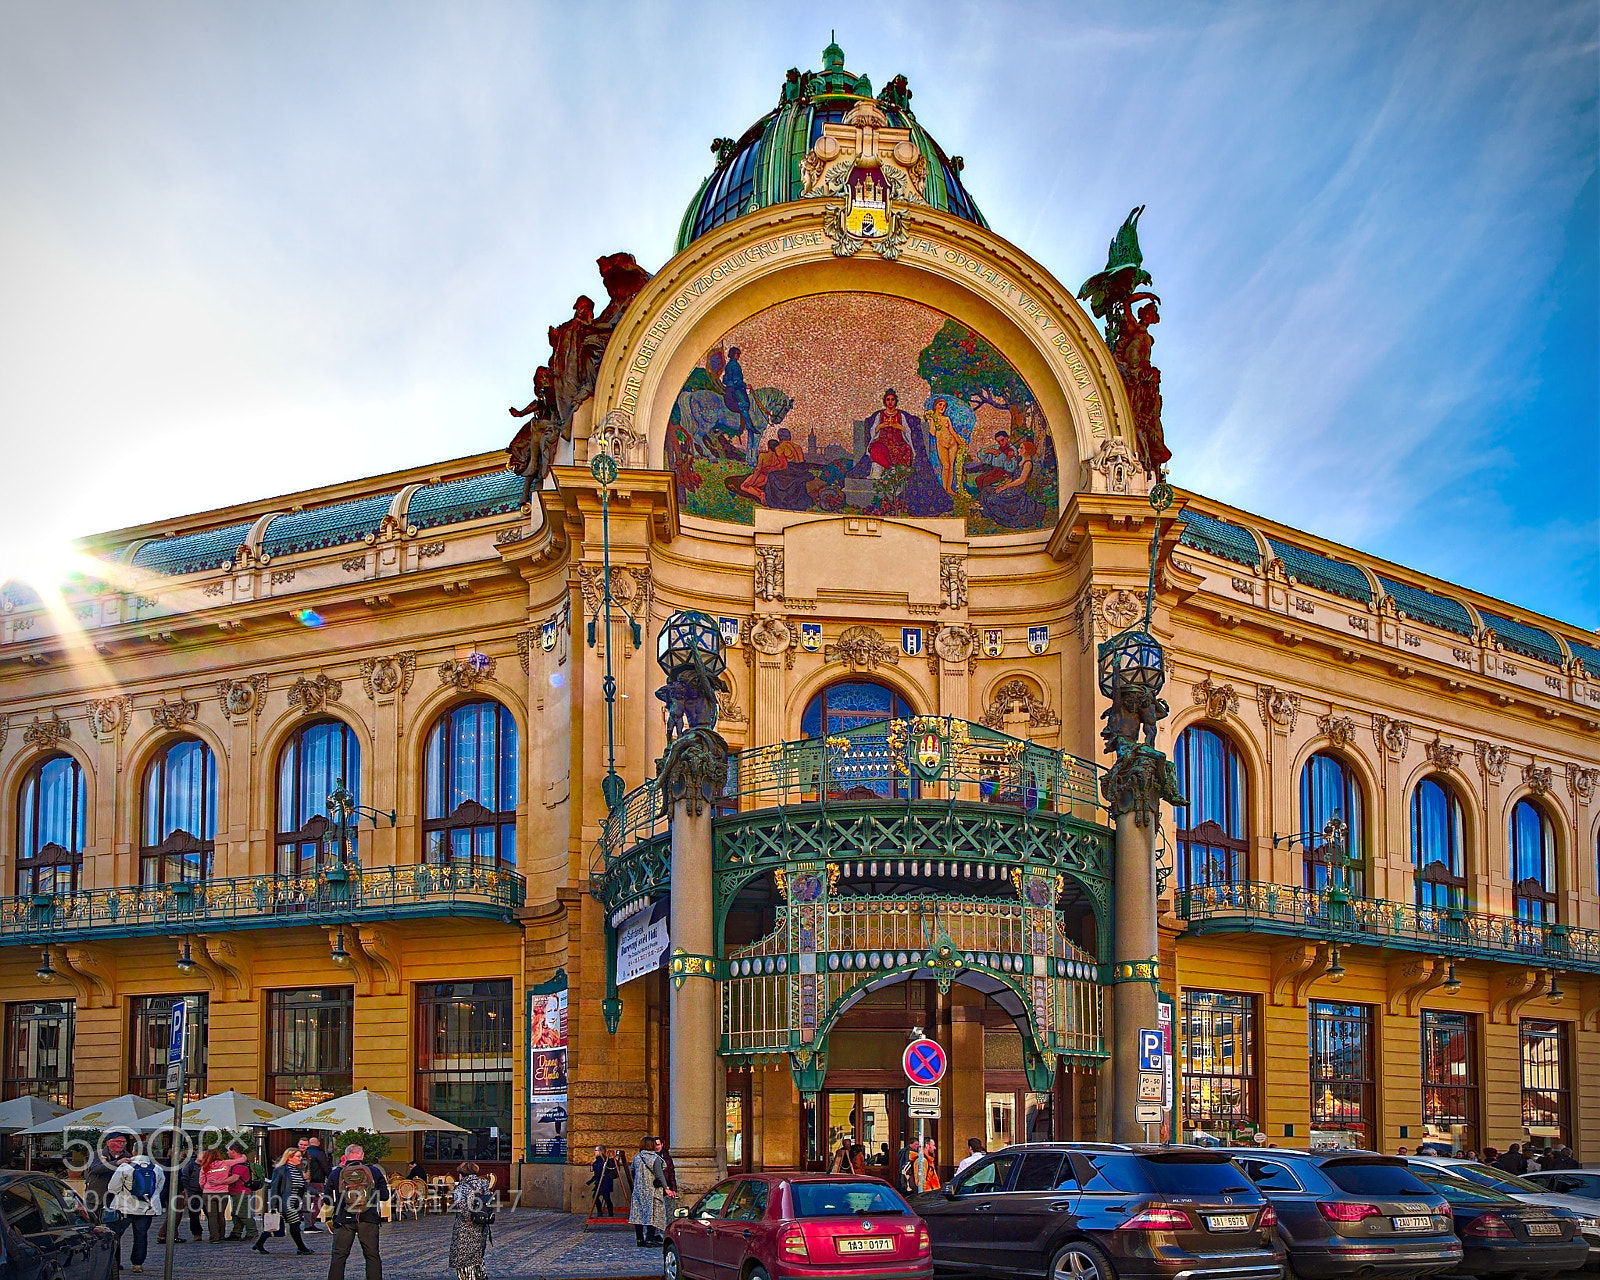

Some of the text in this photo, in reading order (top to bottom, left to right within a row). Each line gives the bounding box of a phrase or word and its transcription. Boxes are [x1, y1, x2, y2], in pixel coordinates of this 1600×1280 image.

[907, 237, 941, 258] JAK
[943, 248, 1017, 298] ODOLALAS
[620, 377, 642, 415] ZDAR
[684, 254, 747, 298] VZDORUJ
[172, 1010, 182, 1045] P
[1144, 1034, 1159, 1058] P
[1412, 1217, 1429, 1227] 7713
[847, 1240, 890, 1250] 1A3 0171
